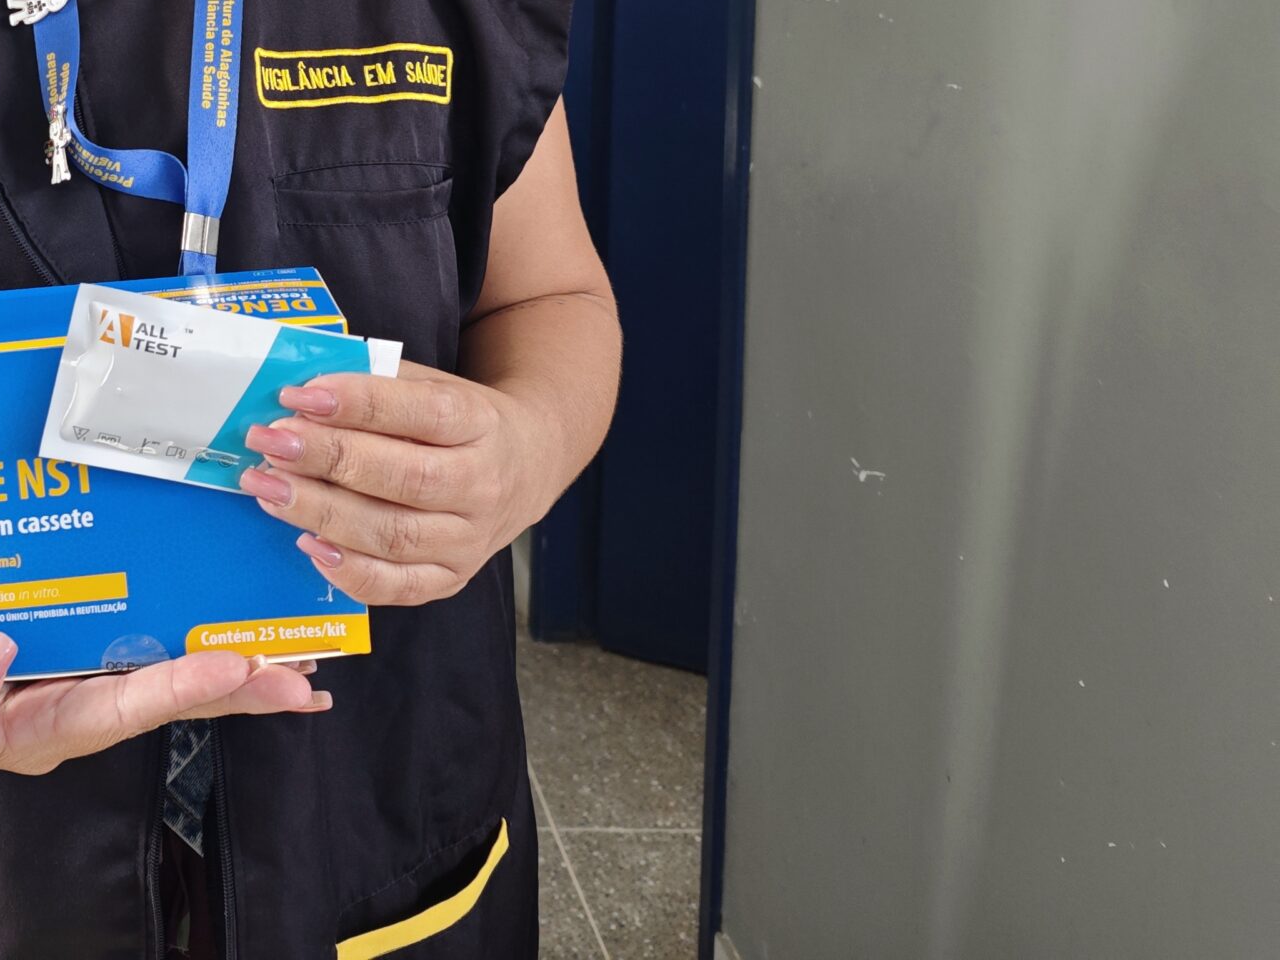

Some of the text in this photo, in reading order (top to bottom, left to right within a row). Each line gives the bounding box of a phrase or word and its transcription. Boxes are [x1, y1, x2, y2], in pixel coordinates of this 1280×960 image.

[221, 30, 234, 46] de
[204, 41, 215, 63] em
[261, 55, 447, 92] VIGILÂNCIA EM SAÚDE
[201, 65, 216, 110] Saúde
[216, 48, 233, 128] Alagoinhas
[200, 299, 318, 314] DENG
[261, 292, 313, 302] Teste
[135, 322, 168, 340] ALL
[133, 337, 182, 358] TEST
[17, 457, 91, 500] NS1
[18, 509, 94, 534] cassete
[18, 590, 30, 600] in
[6, 611, 29, 622] ÚNICO
[33, 608, 69, 619] PROIBIDA
[69, 607, 76, 616] A
[76, 600, 127, 615] REUTILIZAÇÃO
[200, 622, 347, 646] Contém 25 testes/kit
